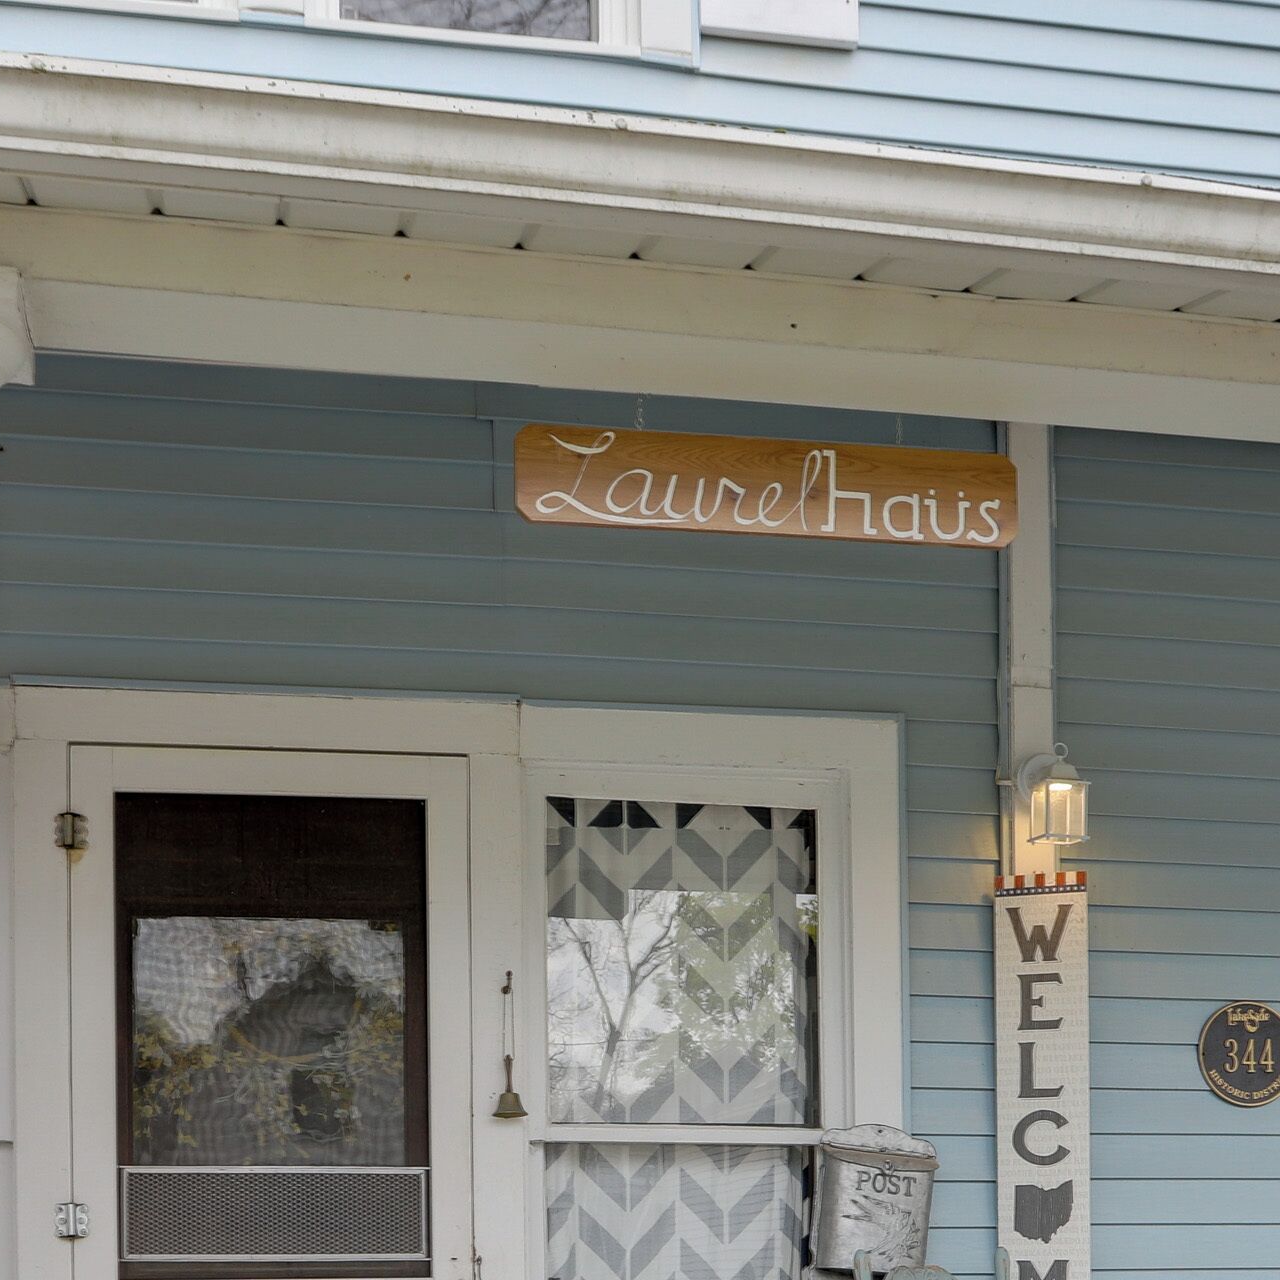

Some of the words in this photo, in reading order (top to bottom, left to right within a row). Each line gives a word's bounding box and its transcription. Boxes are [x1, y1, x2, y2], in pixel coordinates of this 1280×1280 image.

[1224, 1039, 1274, 1072] 344
[1210, 1069, 1250, 1099] HISTORIC
[855, 1170, 917, 1197] POST
